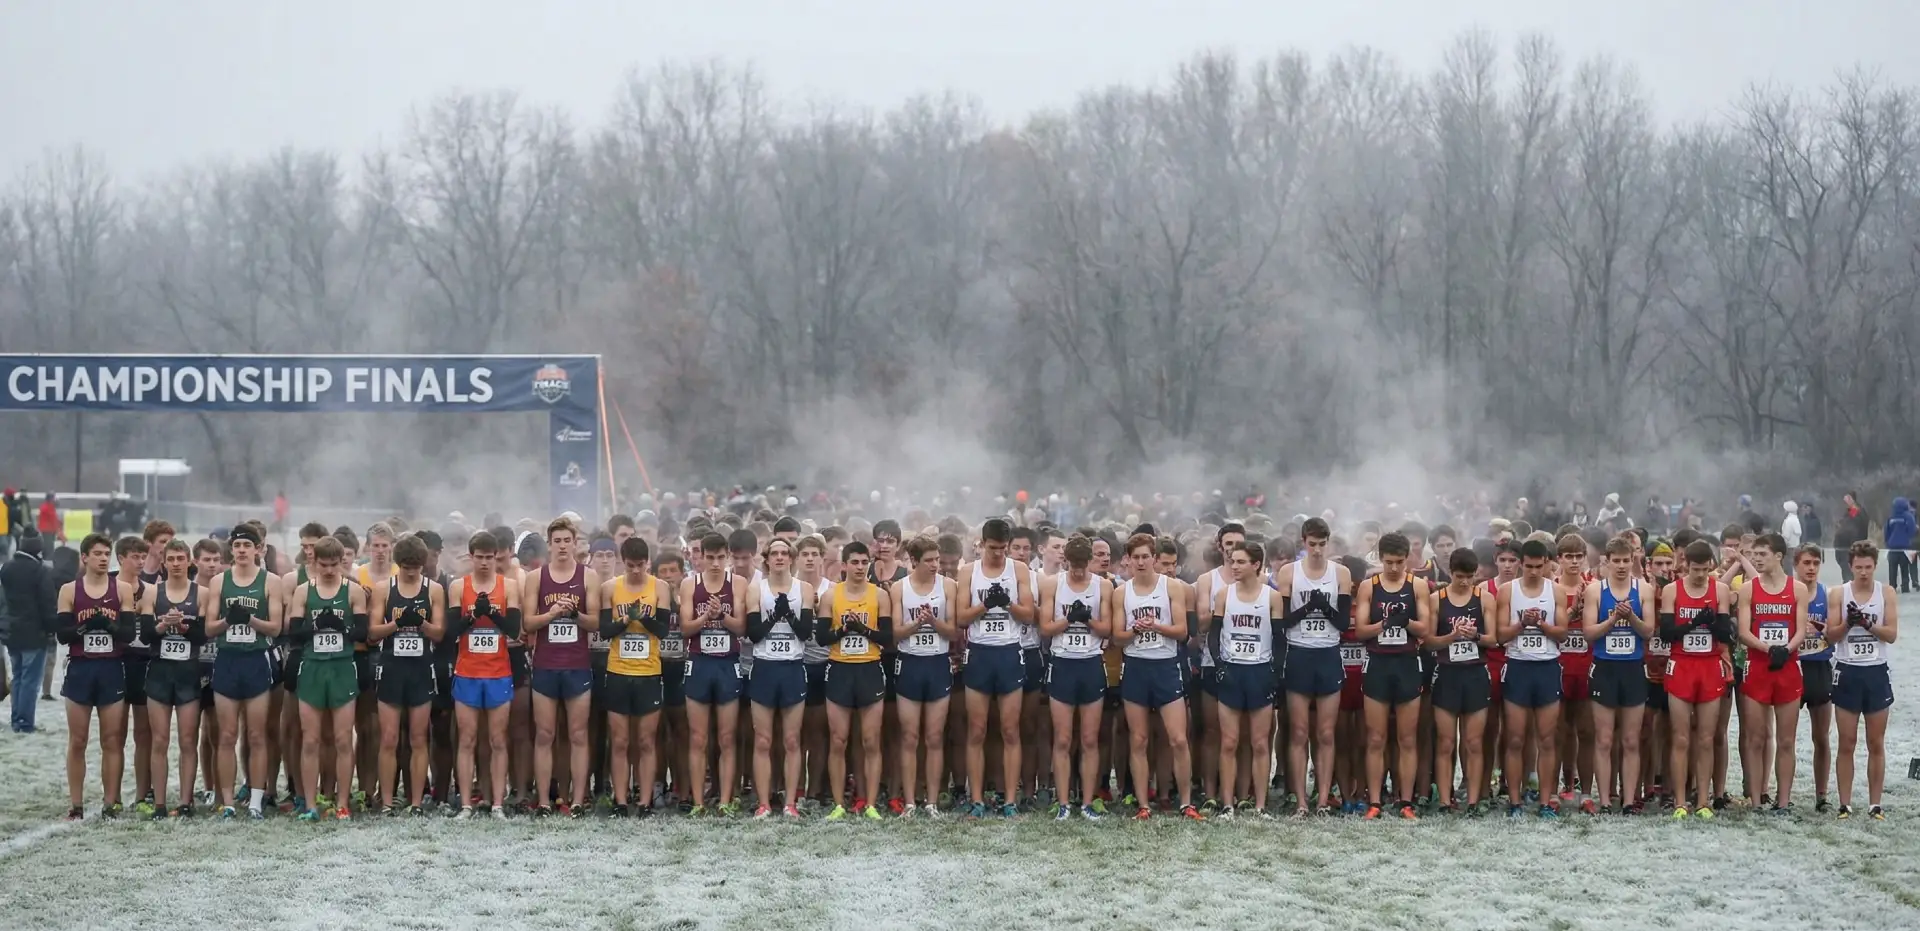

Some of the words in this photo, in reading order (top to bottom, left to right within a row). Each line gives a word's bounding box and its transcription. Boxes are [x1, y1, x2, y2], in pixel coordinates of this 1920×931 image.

[8, 365, 333, 402] CHAMPIONSHIP
[346, 367, 493, 403] FINALS
[553, 626, 573, 635] 307
[89, 636, 108, 646] 260
[1688, 636, 1707, 646] 356
[165, 642, 185, 653] 379
